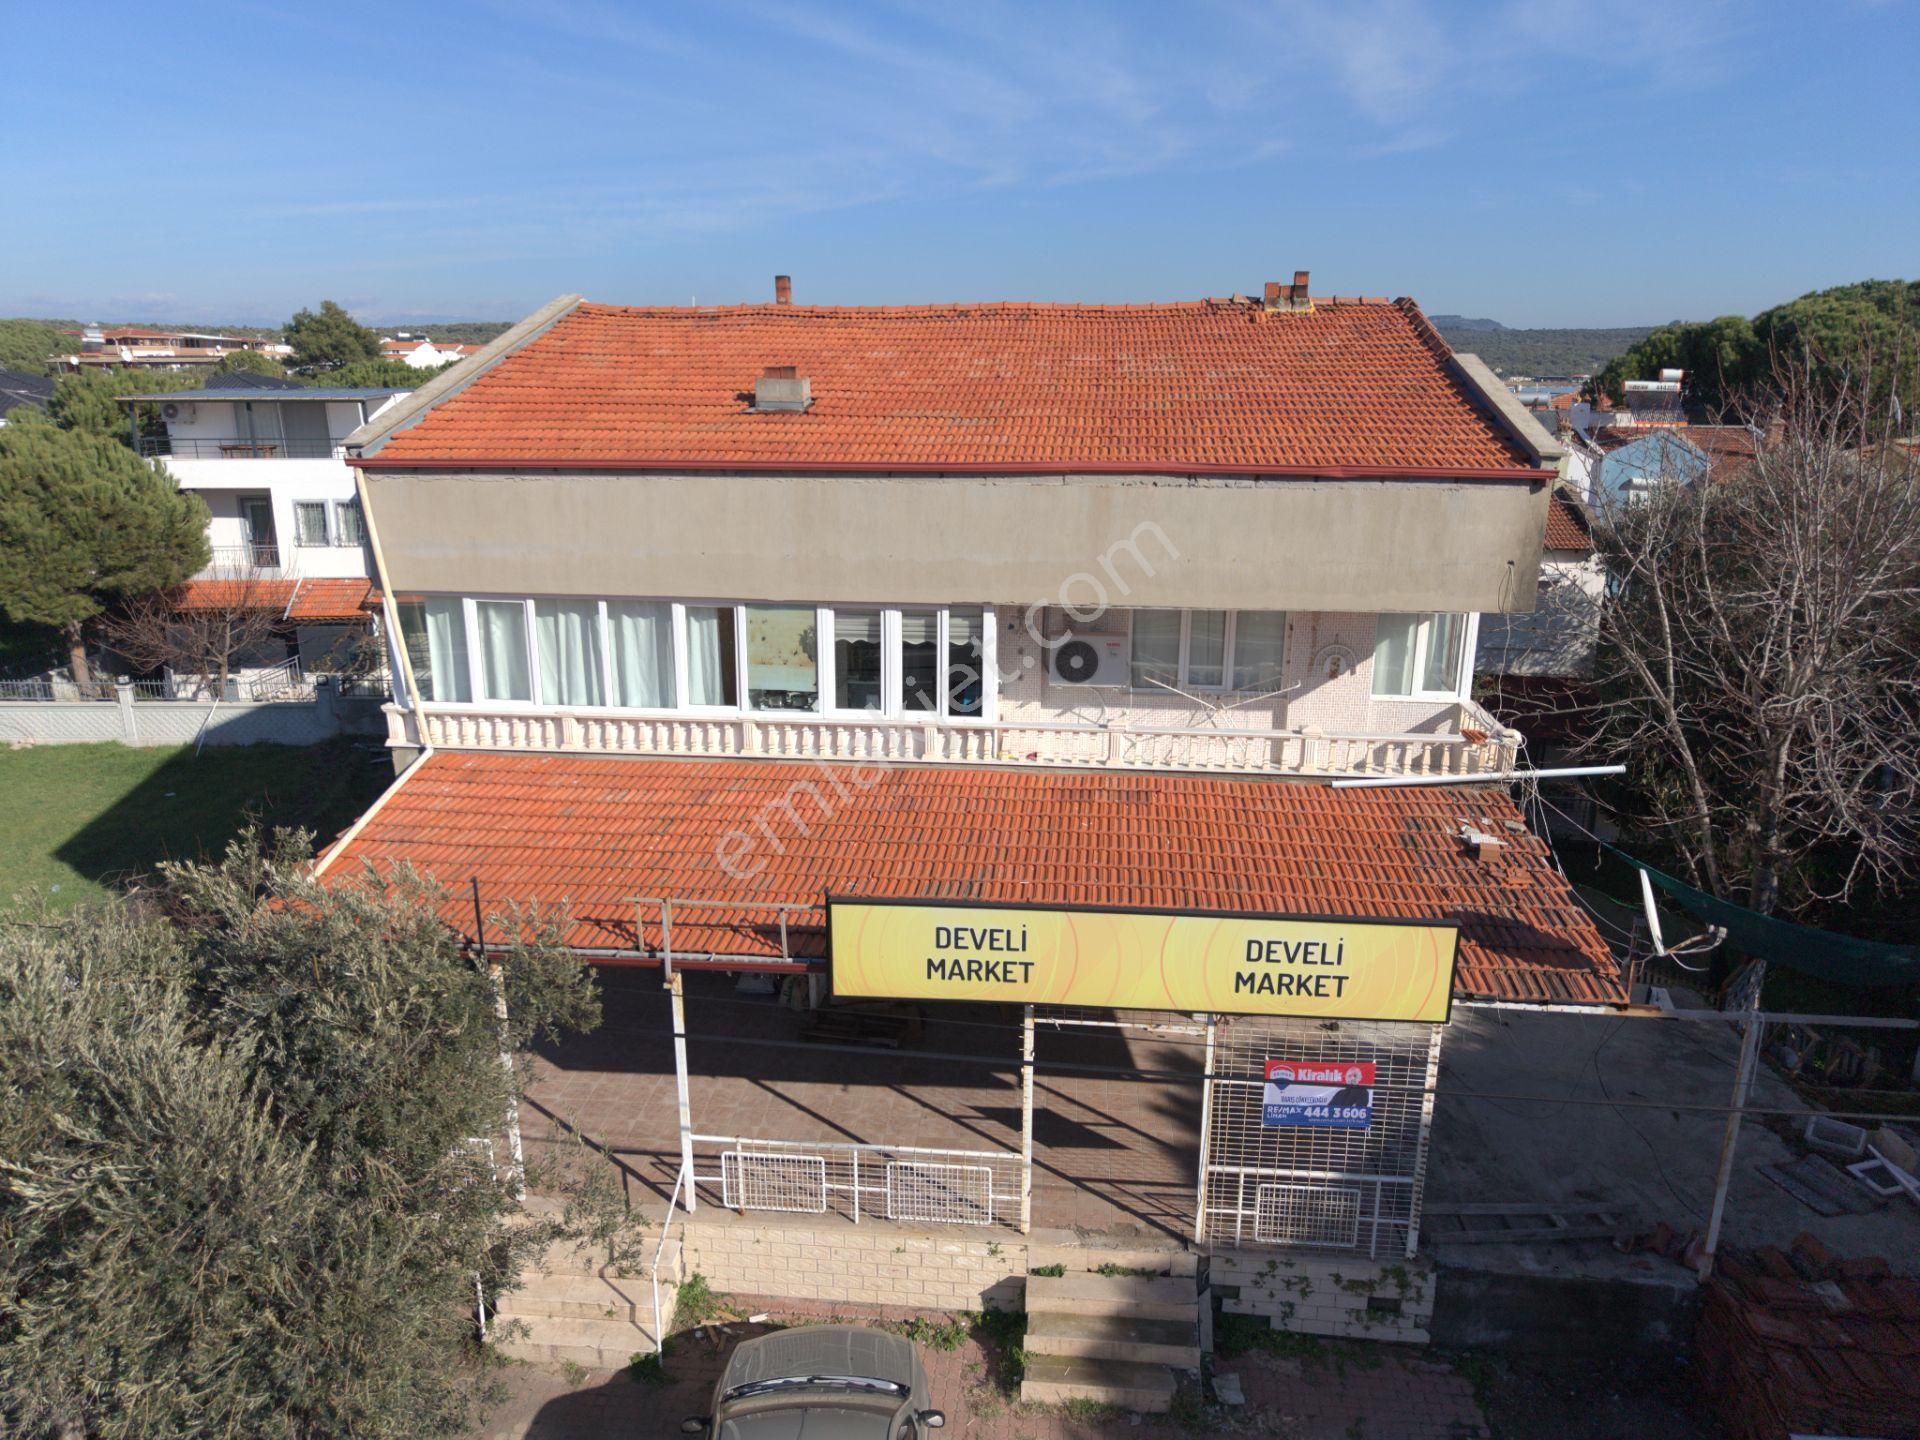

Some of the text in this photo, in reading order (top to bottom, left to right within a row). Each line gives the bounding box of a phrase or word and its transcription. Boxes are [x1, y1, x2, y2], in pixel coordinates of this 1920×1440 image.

[935, 923, 1027, 952] DEVELİ
[1246, 937, 1344, 966] DEVELİ
[927, 958, 1035, 984] MARKET
[1234, 971, 1350, 998] MARKET
[1303, 1106, 1329, 1118] 444
